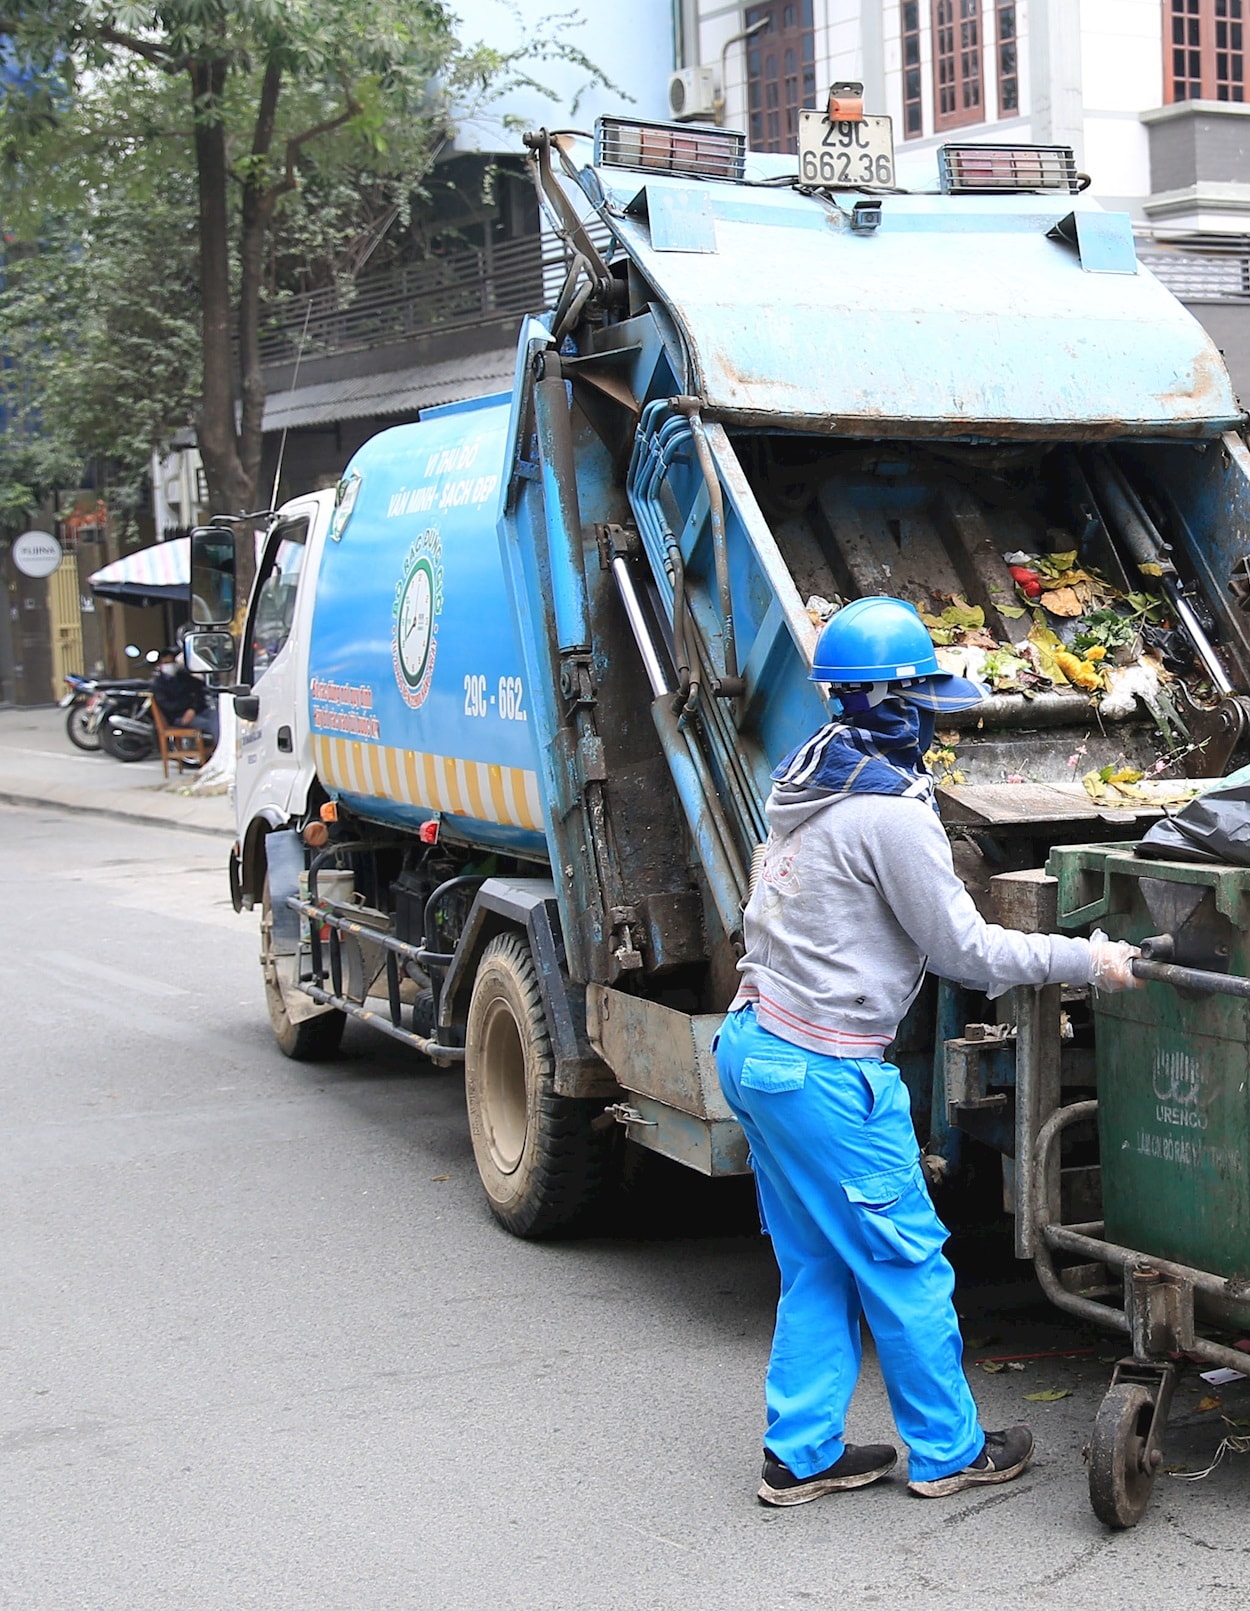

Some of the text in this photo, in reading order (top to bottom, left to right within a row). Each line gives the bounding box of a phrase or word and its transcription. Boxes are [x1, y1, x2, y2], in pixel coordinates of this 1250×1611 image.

[821, 115, 869, 149] 29C
[802, 150, 892, 184] 662.36
[464, 674, 487, 718] 29C
[1155, 1104, 1208, 1130] URENCO
